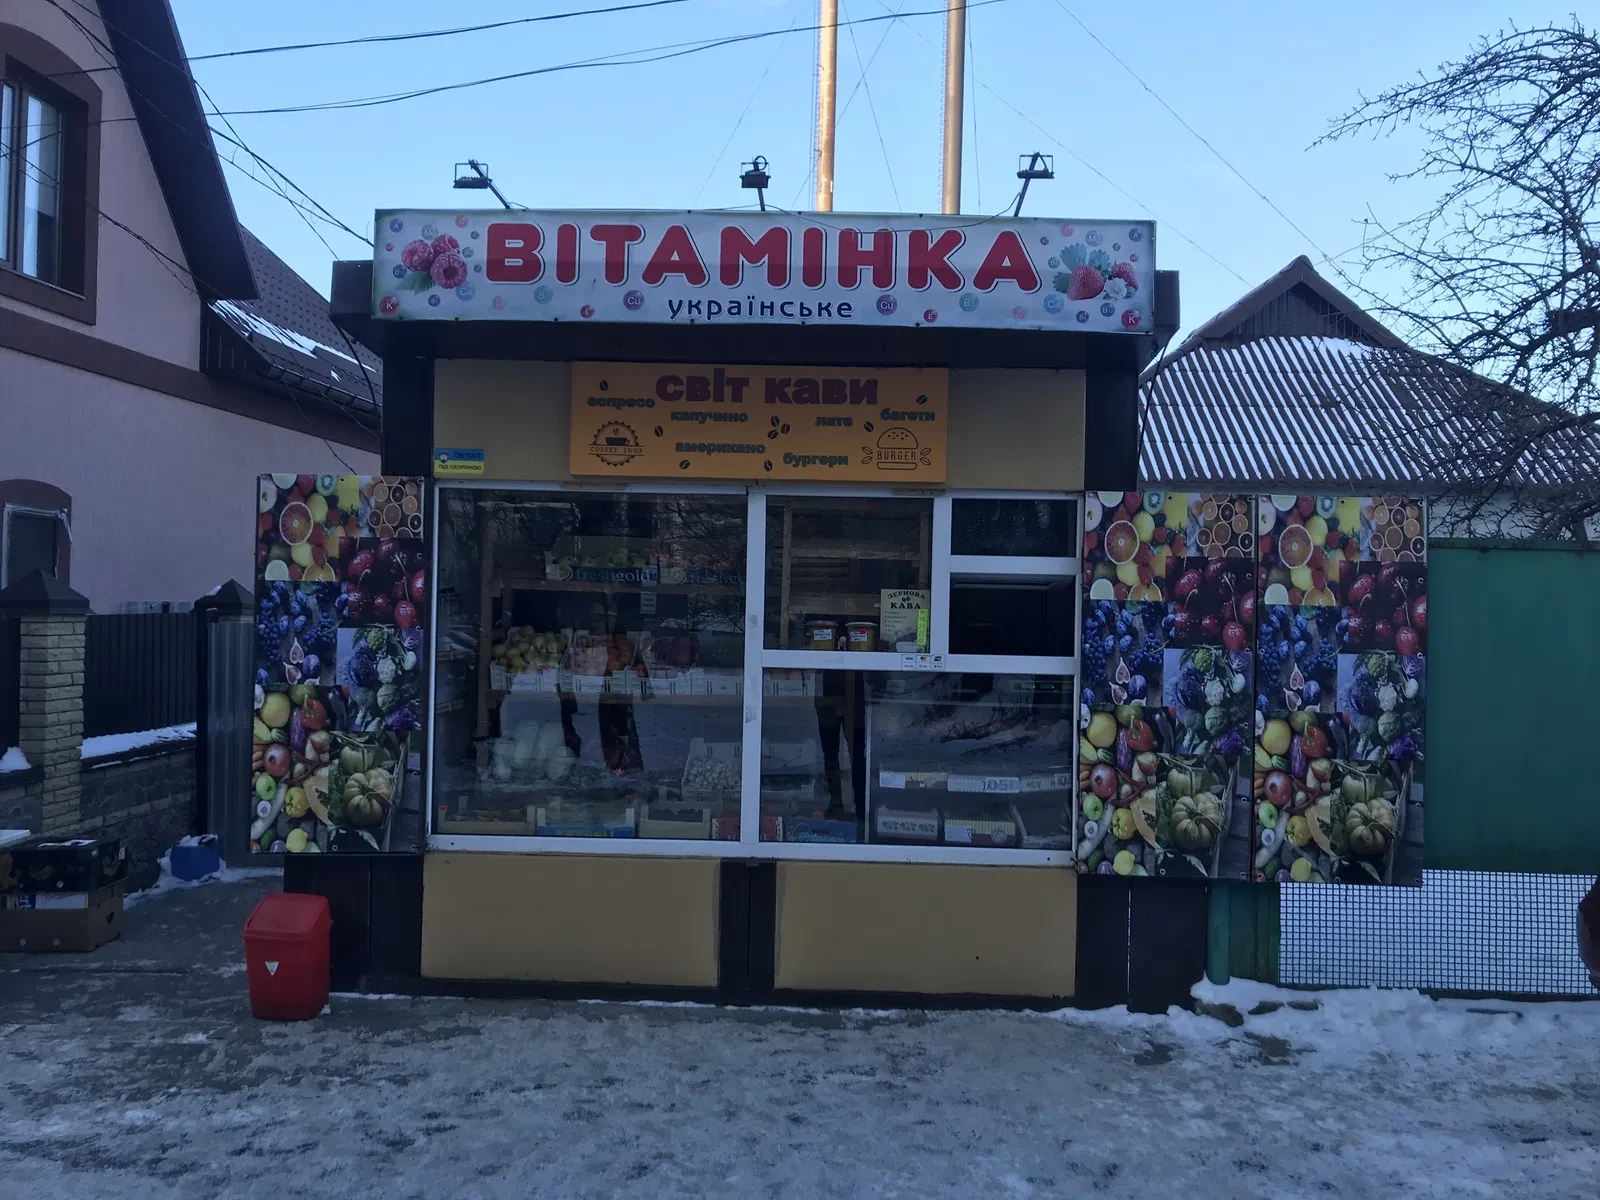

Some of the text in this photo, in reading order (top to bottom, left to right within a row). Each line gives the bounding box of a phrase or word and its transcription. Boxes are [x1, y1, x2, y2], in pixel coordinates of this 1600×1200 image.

[486, 222, 1040, 292] ВІТАМІНКА
[668, 295, 853, 320] українське
[764, 378, 878, 405] кави
[587, 396, 656, 410] еспресо
[670, 411, 749, 424] капучино
[814, 416, 853, 427] лате
[880, 408, 935, 422] багети
[589, 446, 644, 455] COFFEE SHOP
[675, 442, 766, 456] американо
[877, 450, 917, 461] BURGER
[782, 452, 849, 468] бургери
[887, 590, 925, 600] ЗЕРНОВА
[890, 602, 921, 610] КАВА
